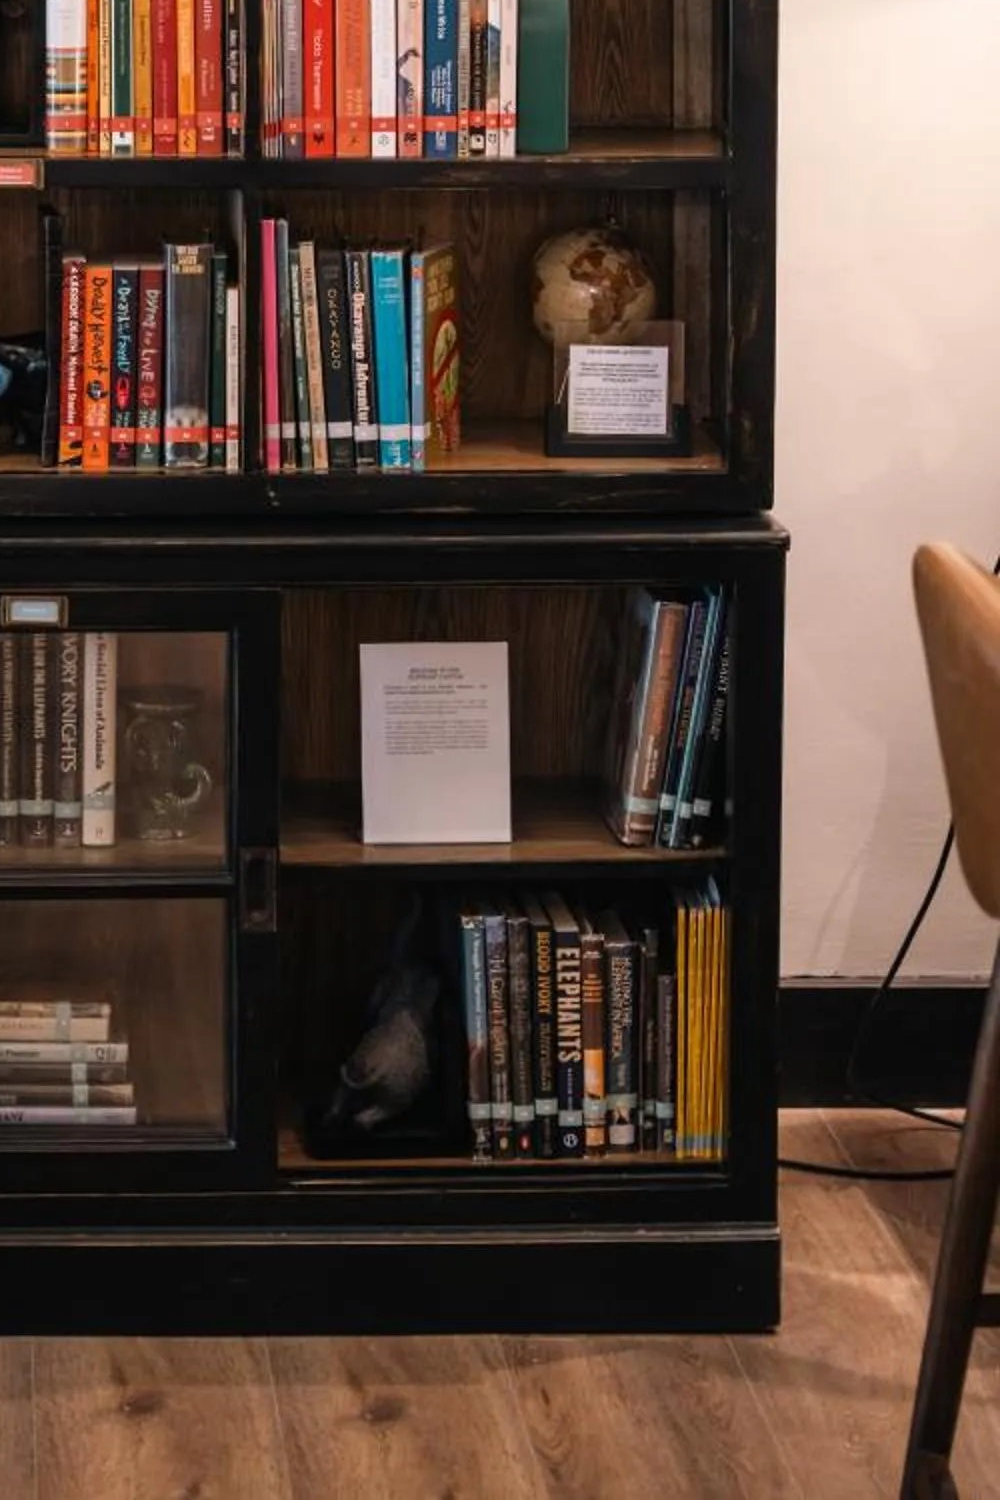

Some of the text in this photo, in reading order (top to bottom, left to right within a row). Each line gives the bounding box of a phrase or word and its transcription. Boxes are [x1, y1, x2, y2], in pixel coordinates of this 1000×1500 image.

[68, 320, 79, 353] DEATH
[89, 323, 109, 375] Harvest
[327, 288, 342, 370] OKAVANGO
[351, 291, 367, 360] Okavango
[140, 348, 157, 382] LIVE
[60, 635, 78, 773] VORY KNIGHTS
[95, 643, 106, 770] Social Lives of Animals
[537, 975, 552, 1015] IVORY
[557, 946, 582, 1063] ELEPHANTS
